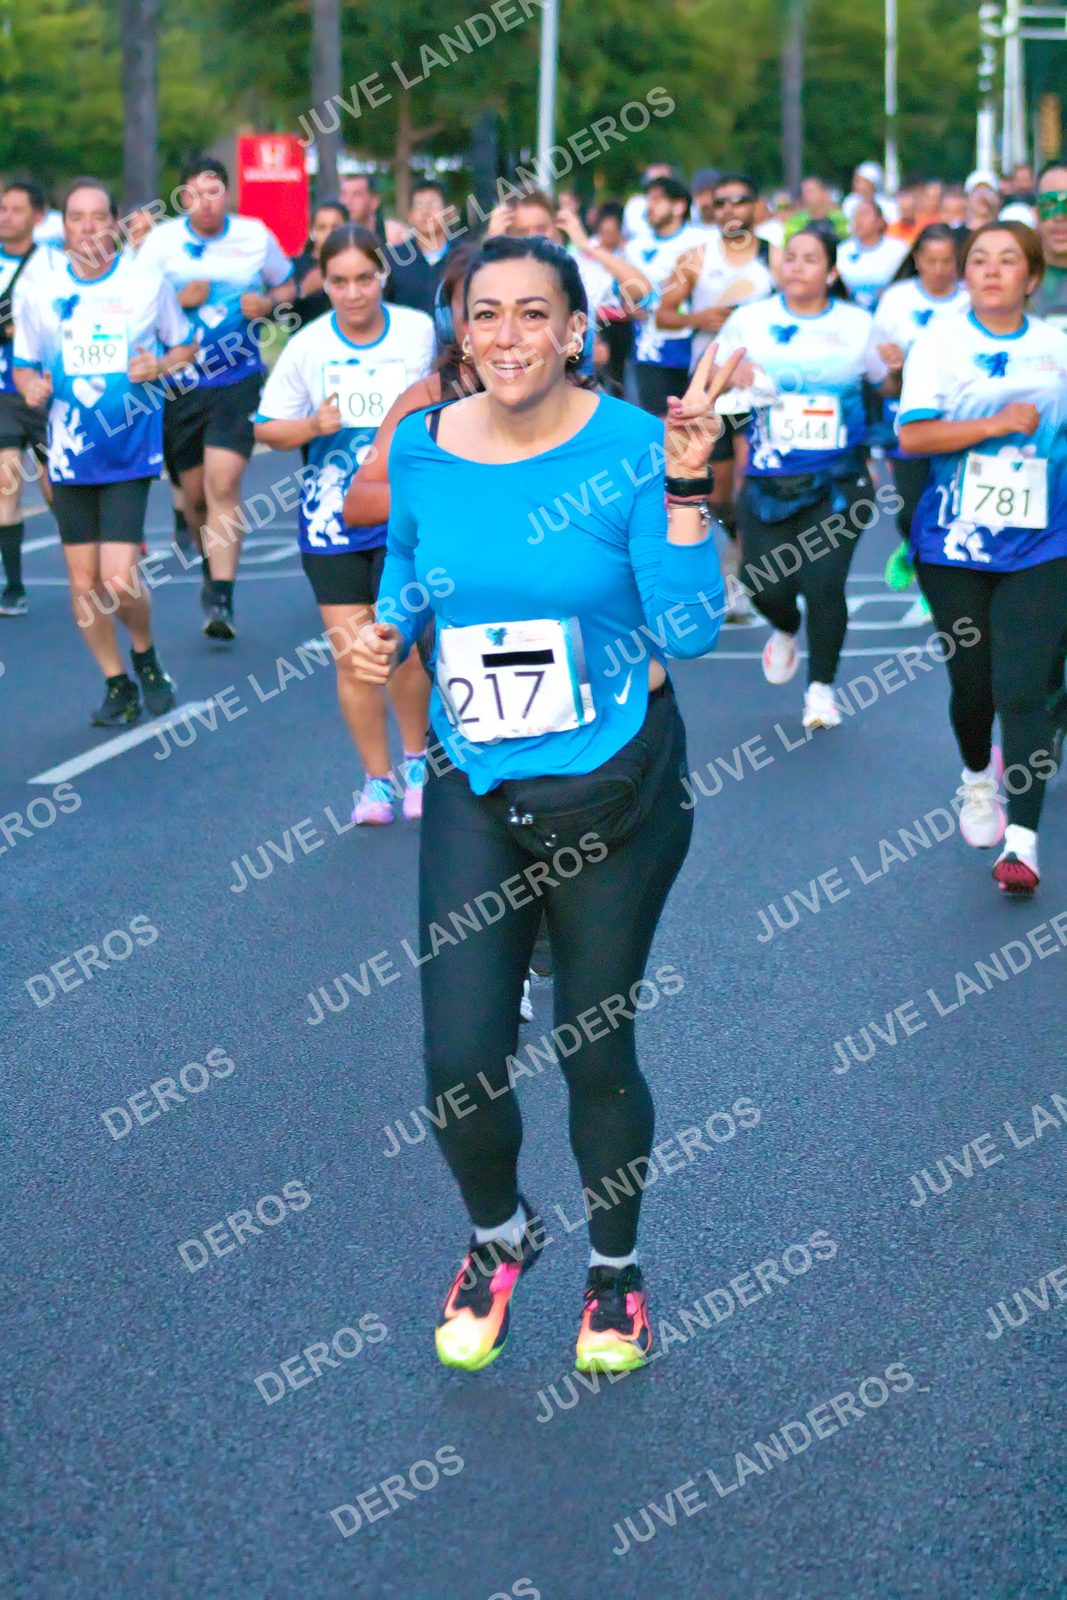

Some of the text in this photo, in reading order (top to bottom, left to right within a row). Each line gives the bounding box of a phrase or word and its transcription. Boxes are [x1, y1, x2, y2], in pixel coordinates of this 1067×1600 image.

[72, 343, 117, 368] 389
[779, 418, 829, 441] 544
[975, 484, 1031, 518] 781
[447, 670, 546, 724] 217
